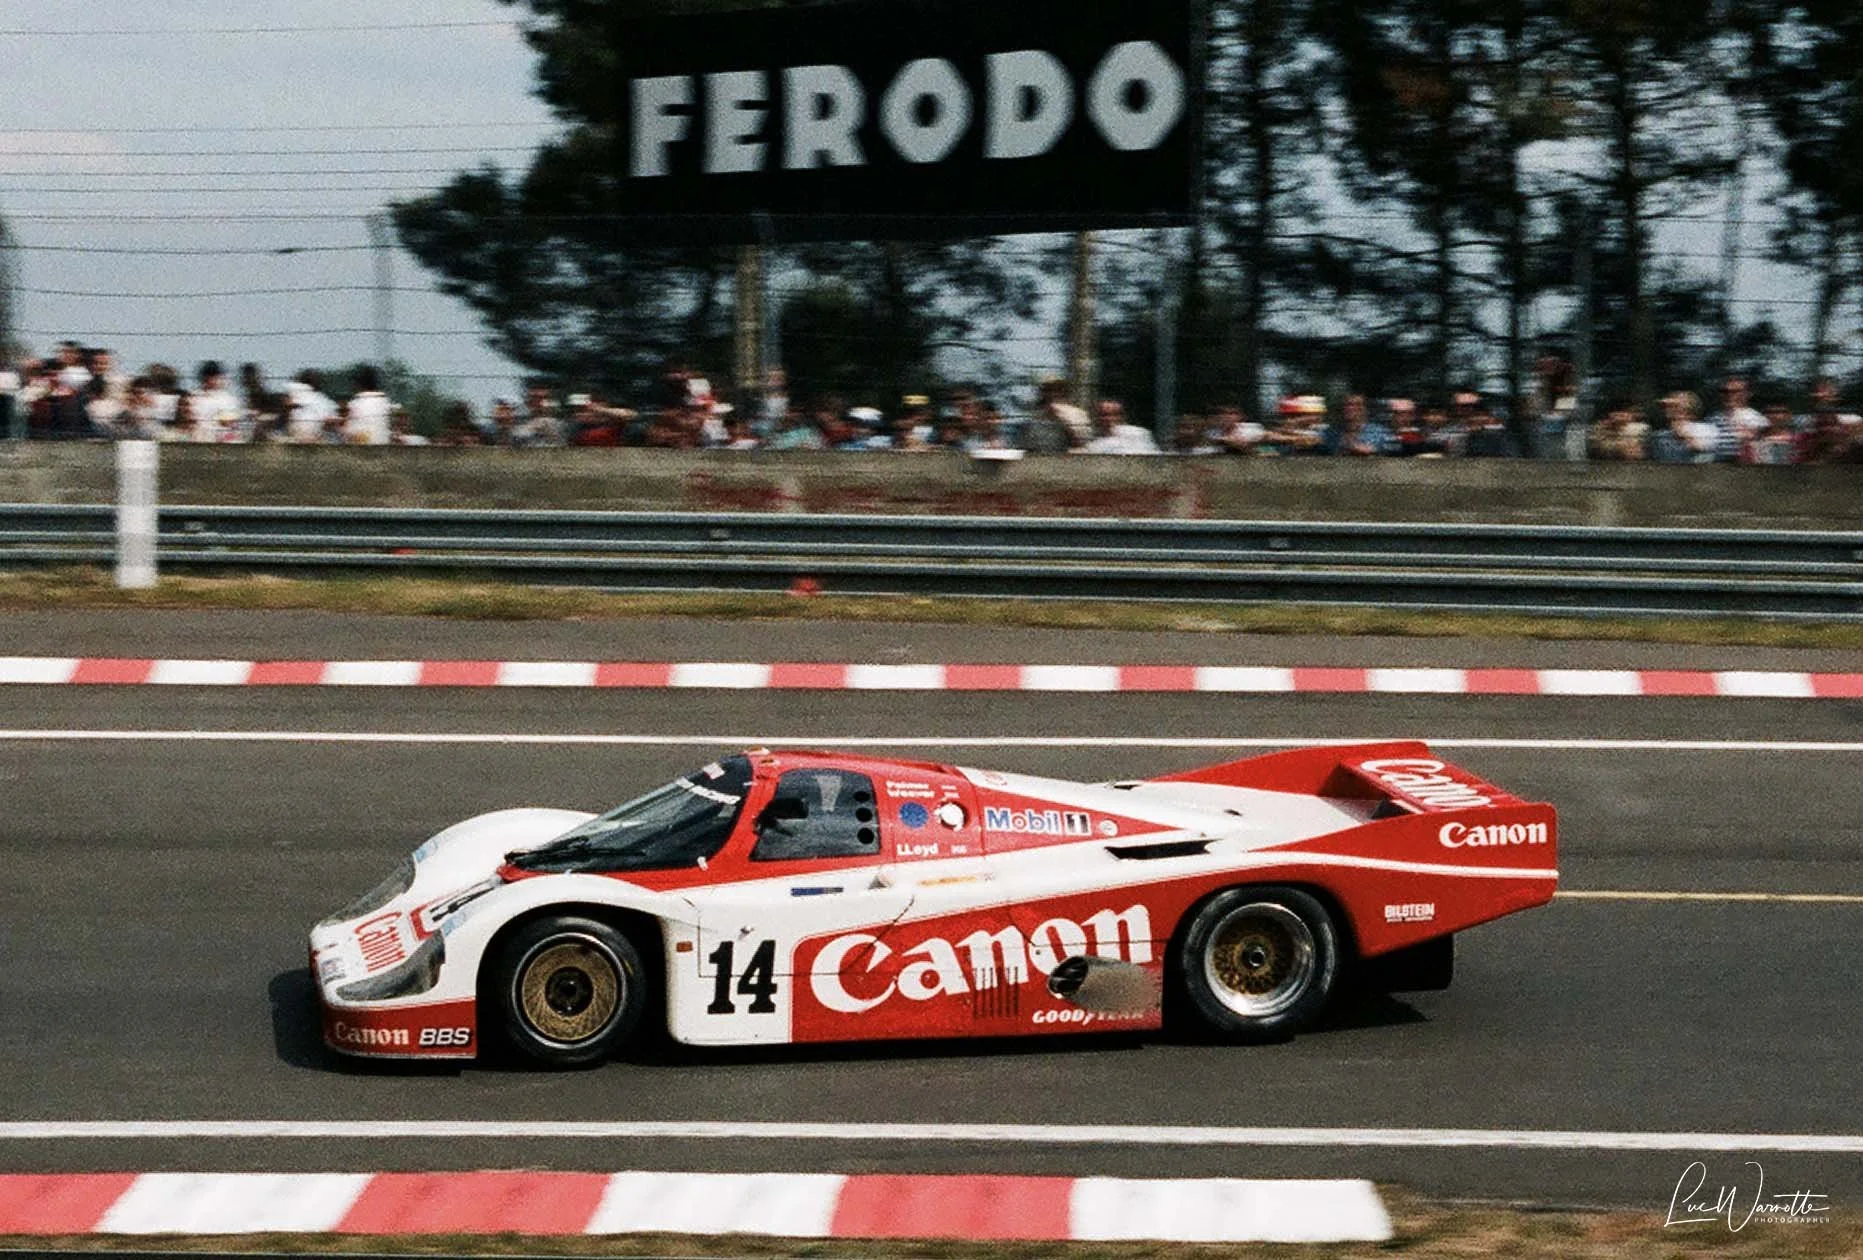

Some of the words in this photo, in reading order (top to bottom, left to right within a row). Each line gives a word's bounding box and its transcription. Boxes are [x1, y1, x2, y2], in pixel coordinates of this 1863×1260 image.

[629, 40, 1187, 177] FERODO
[1360, 758, 1490, 812] Cano
[985, 808, 1060, 834] Mobil
[1065, 812, 1090, 834] 1
[1438, 821, 1549, 849] Canon
[1384, 902, 1435, 918] BILSTEIN
[707, 939, 778, 1014] 14
[810, 903, 1154, 1014] Canon
[334, 1020, 410, 1045] Canon
[418, 1027, 471, 1046] BBS
